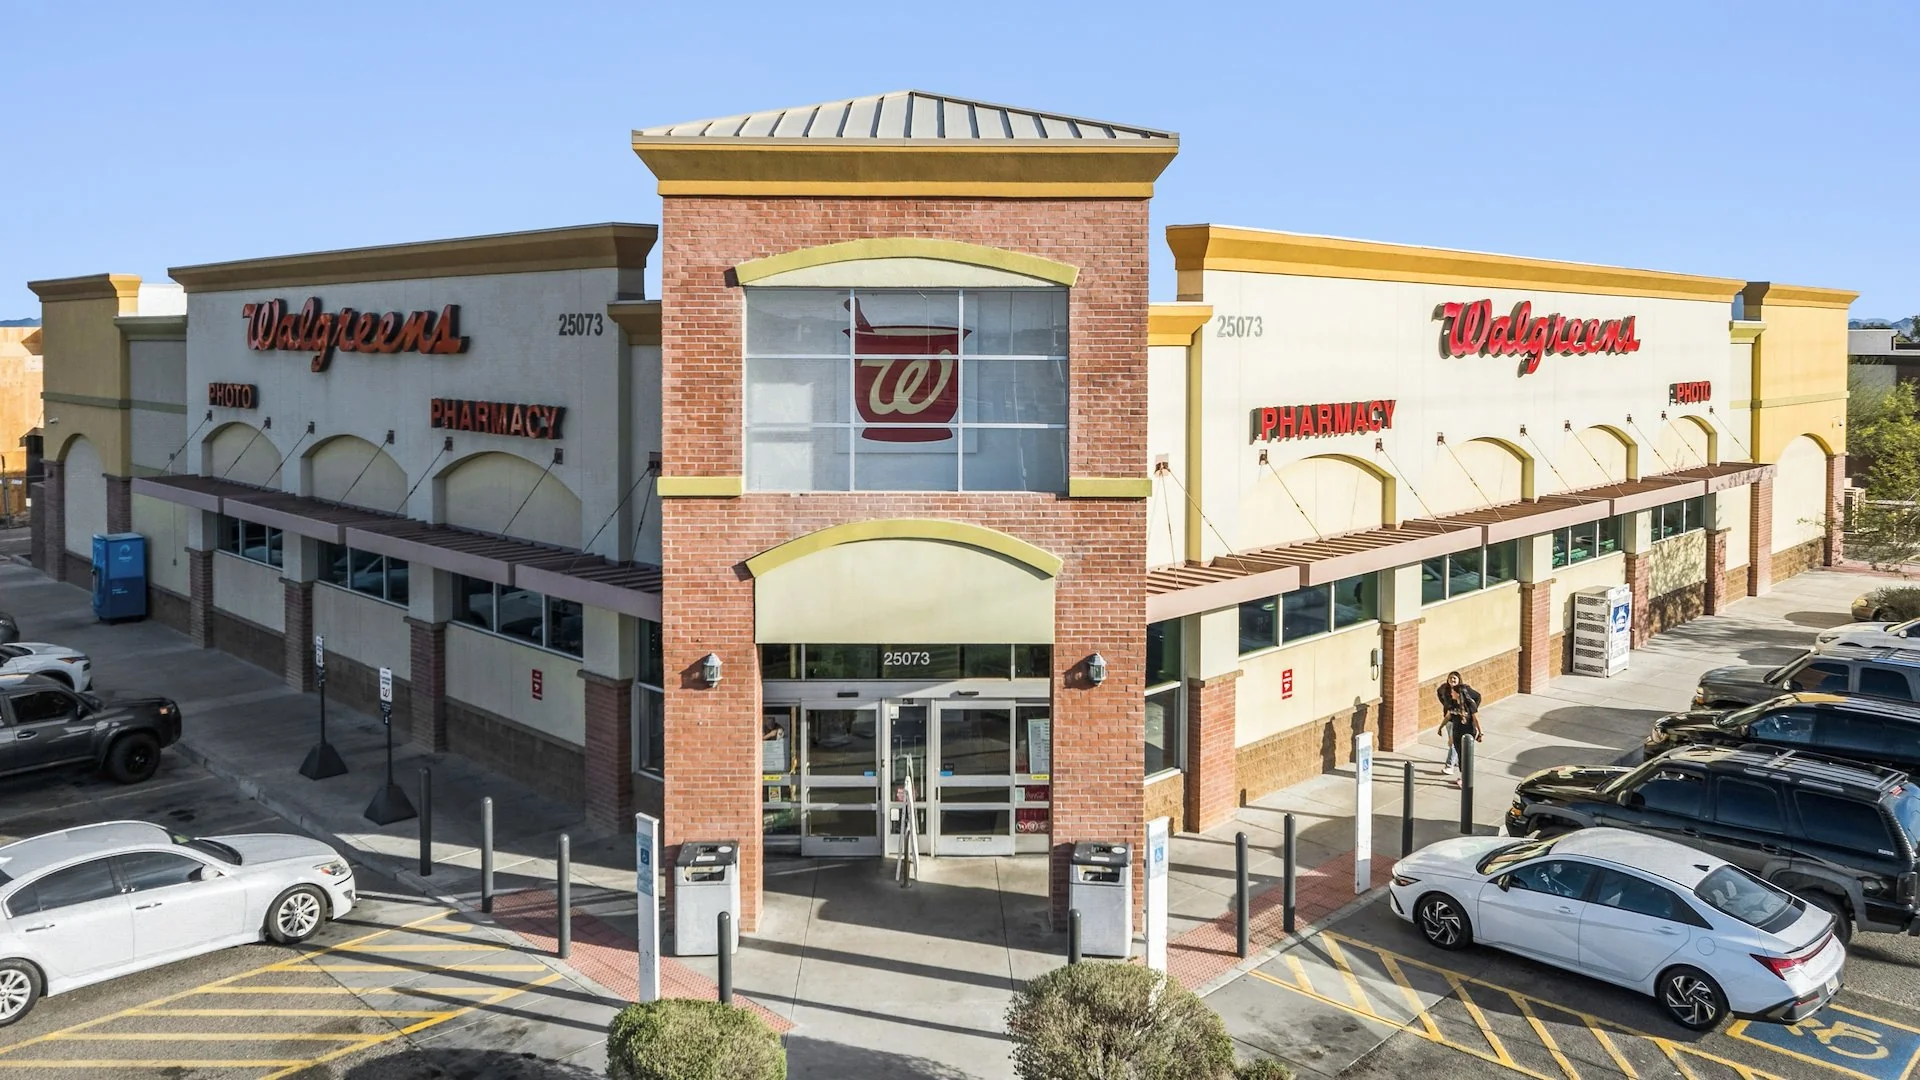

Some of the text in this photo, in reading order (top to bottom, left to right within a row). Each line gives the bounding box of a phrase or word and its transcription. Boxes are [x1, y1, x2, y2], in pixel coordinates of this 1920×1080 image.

[242, 297, 466, 373] Walgreens
[558, 312, 603, 336] 25073
[1216, 314, 1263, 338] 25073
[1442, 298, 1641, 374] Walgreens
[208, 382, 252, 409] PHOTO
[860, 348, 954, 415] W
[1675, 380, 1711, 404] PHOTO
[431, 398, 561, 440] PHARMACY
[1260, 399, 1396, 440] PHARMACY
[883, 651, 930, 666] 25073
